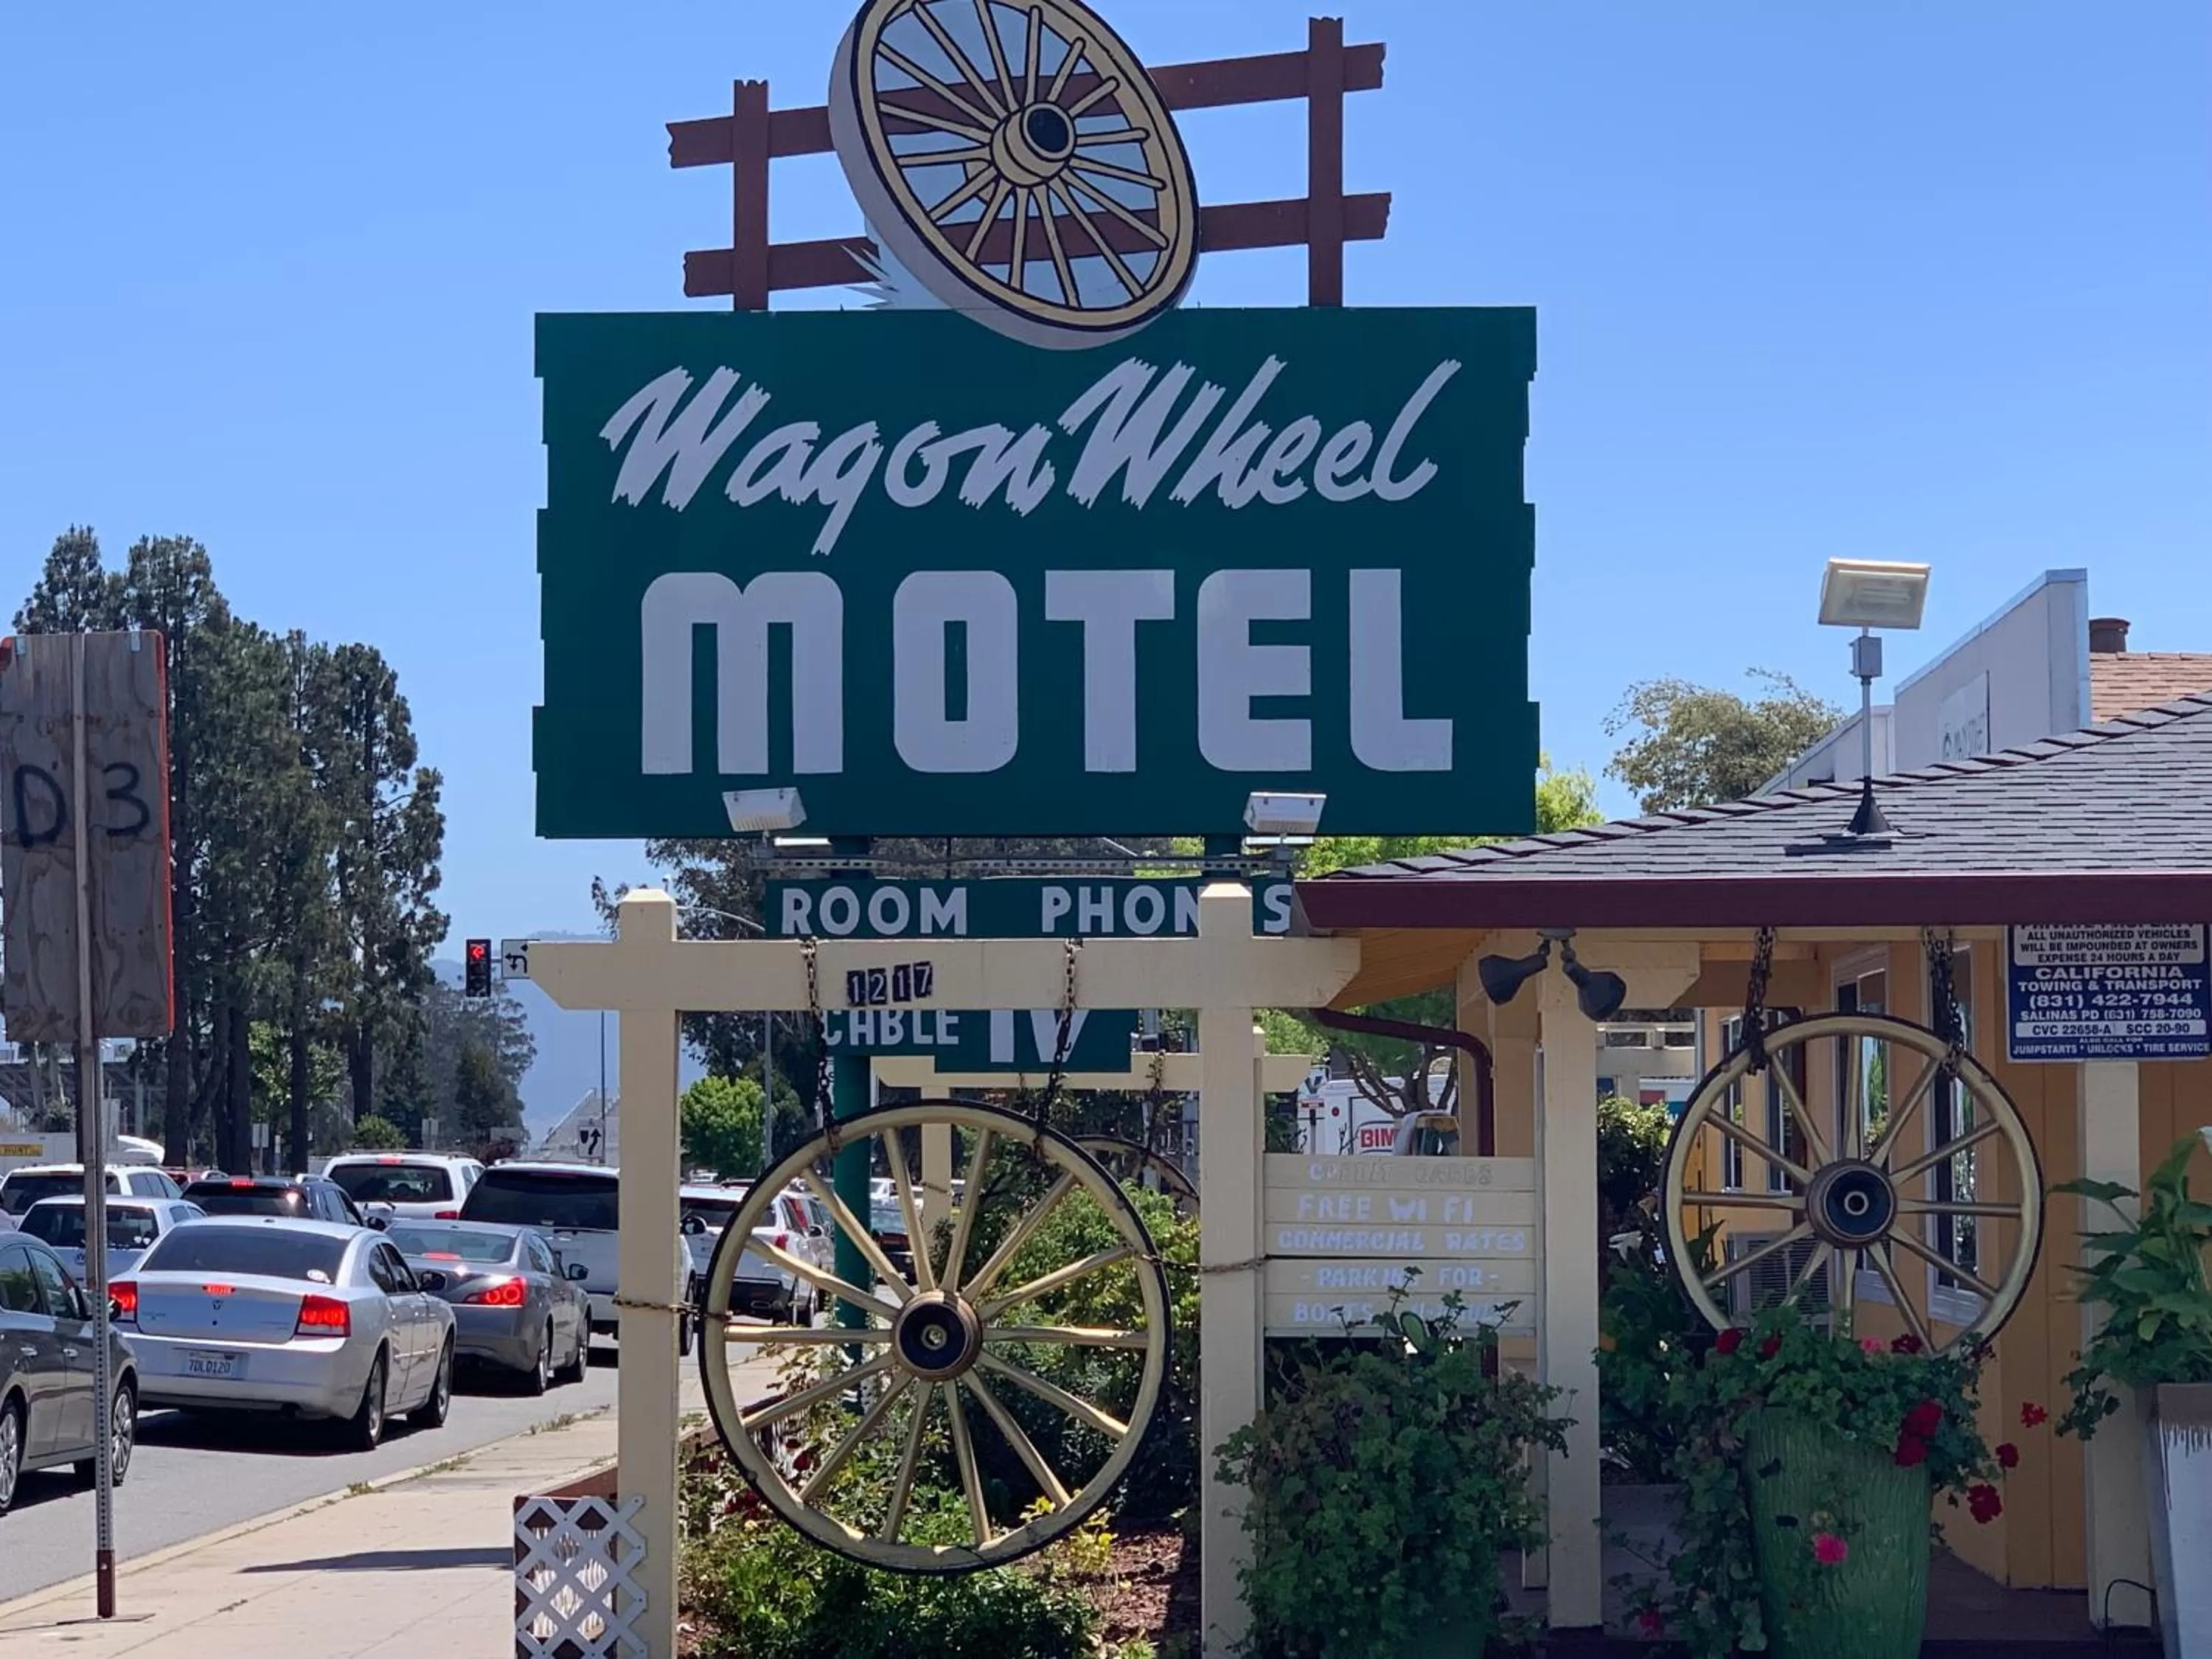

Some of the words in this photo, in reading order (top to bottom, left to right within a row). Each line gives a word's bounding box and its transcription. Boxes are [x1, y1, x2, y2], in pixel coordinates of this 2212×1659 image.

[599, 366, 1054, 554] Wagon
[1058, 355, 1461, 509] Wheel
[642, 569, 1453, 773] MOTEL
[13, 762, 66, 849] D
[102, 762, 150, 838] 3
[782, 886, 967, 935] ROOM
[1042, 885, 1292, 935] PHONS
[2028, 931, 2046, 940] ALL
[2050, 930, 2134, 940] UNAUTHORIZED
[2138, 929, 2191, 939] VEHICLES
[2021, 943, 2045, 952] WILL
[2050, 942, 2063, 951] BE
[2067, 942, 2132, 951] IMPOUNDED
[2135, 941, 2148, 950] AT
[2151, 940, 2198, 950] OWNERS
[2037, 953, 2087, 963] EXPENSE
[2090, 953, 2104, 962] 24
[2107, 953, 2146, 961] HOURS
[2149, 953, 2156, 961] A
[2159, 952, 2180, 961] DAY
[2035, 966, 2183, 980] CALIFORNIA
[849, 963, 933, 1004] 1217
[2018, 980, 2083, 992] TOWING
[2088, 980, 2099, 991] &
[2104, 979, 2202, 990] TRANSPORT
[2030, 994, 2084, 1009] (831)
[2092, 992, 2194, 1006] 422-7944
[2020, 1009, 2077, 1021] SALINAS
[2081, 1009, 2100, 1020] PD
[2032, 1024, 2059, 1035] CVC
[2126, 1023, 2152, 1034] SCC
[2012, 1044, 2078, 1054] JUMPSTARTS
[2087, 1043, 2134, 1054] UNLOCKS
[2143, 1043, 2166, 1053] TIRE
[2168, 1042, 2211, 1052] SERVICE
[1297, 1193, 1372, 1221] FREE
[1388, 1196, 1427, 1222] WI
[1444, 1195, 1473, 1224] FI
[1277, 1231, 1426, 1252] COMMERCIAL
[1444, 1231, 1525, 1252] RATES
[1438, 1267, 1484, 1286] FOR
